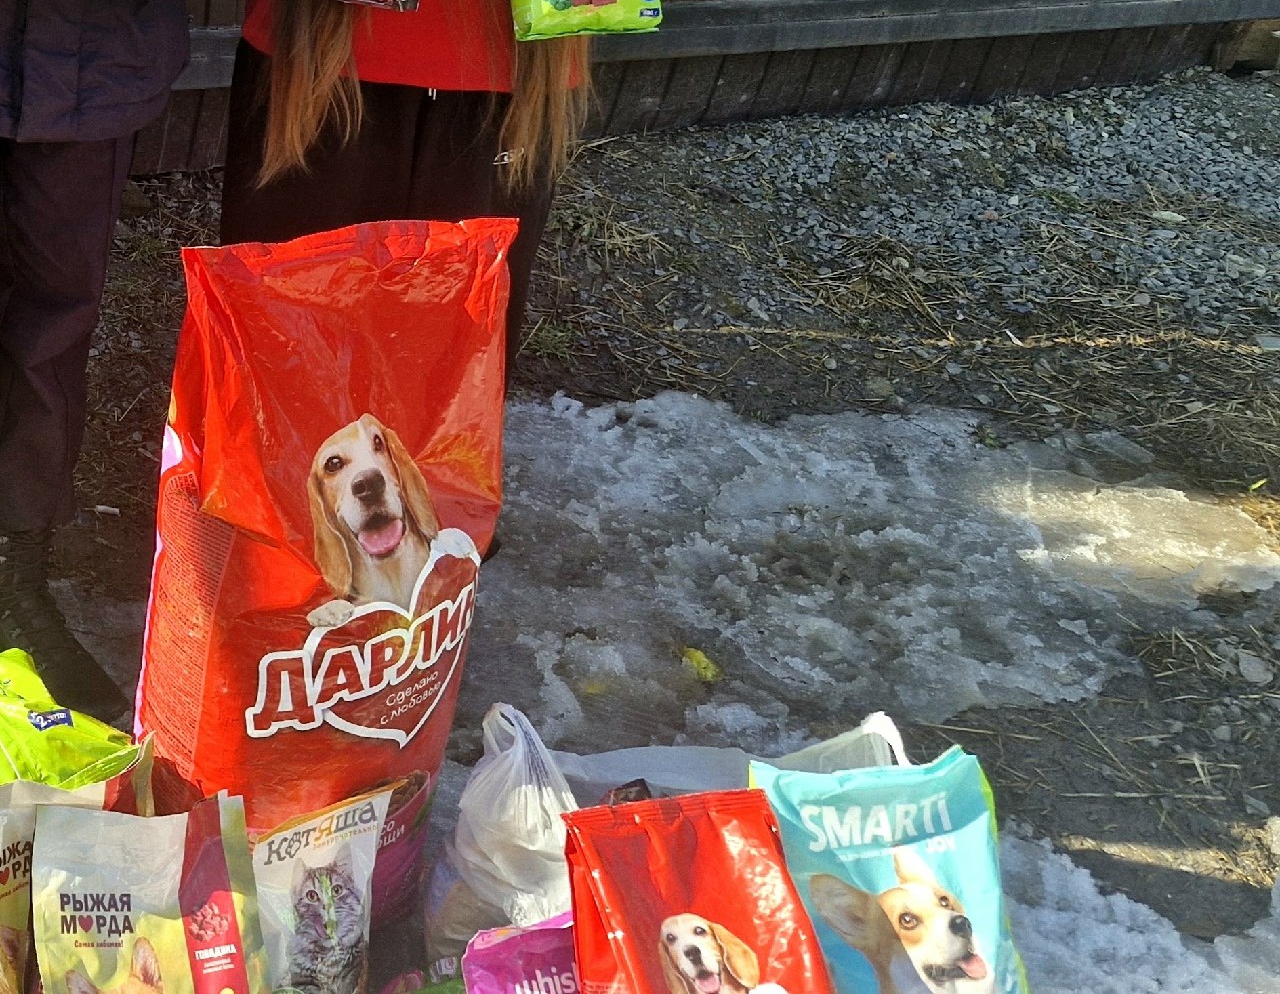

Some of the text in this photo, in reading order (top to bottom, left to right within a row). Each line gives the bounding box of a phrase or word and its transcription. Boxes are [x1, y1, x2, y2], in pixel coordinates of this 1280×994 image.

[385, 671, 438, 706] Сделано
[390, 681, 441, 720] любовью
[60, 894, 131, 912] РЫЖАЯ
